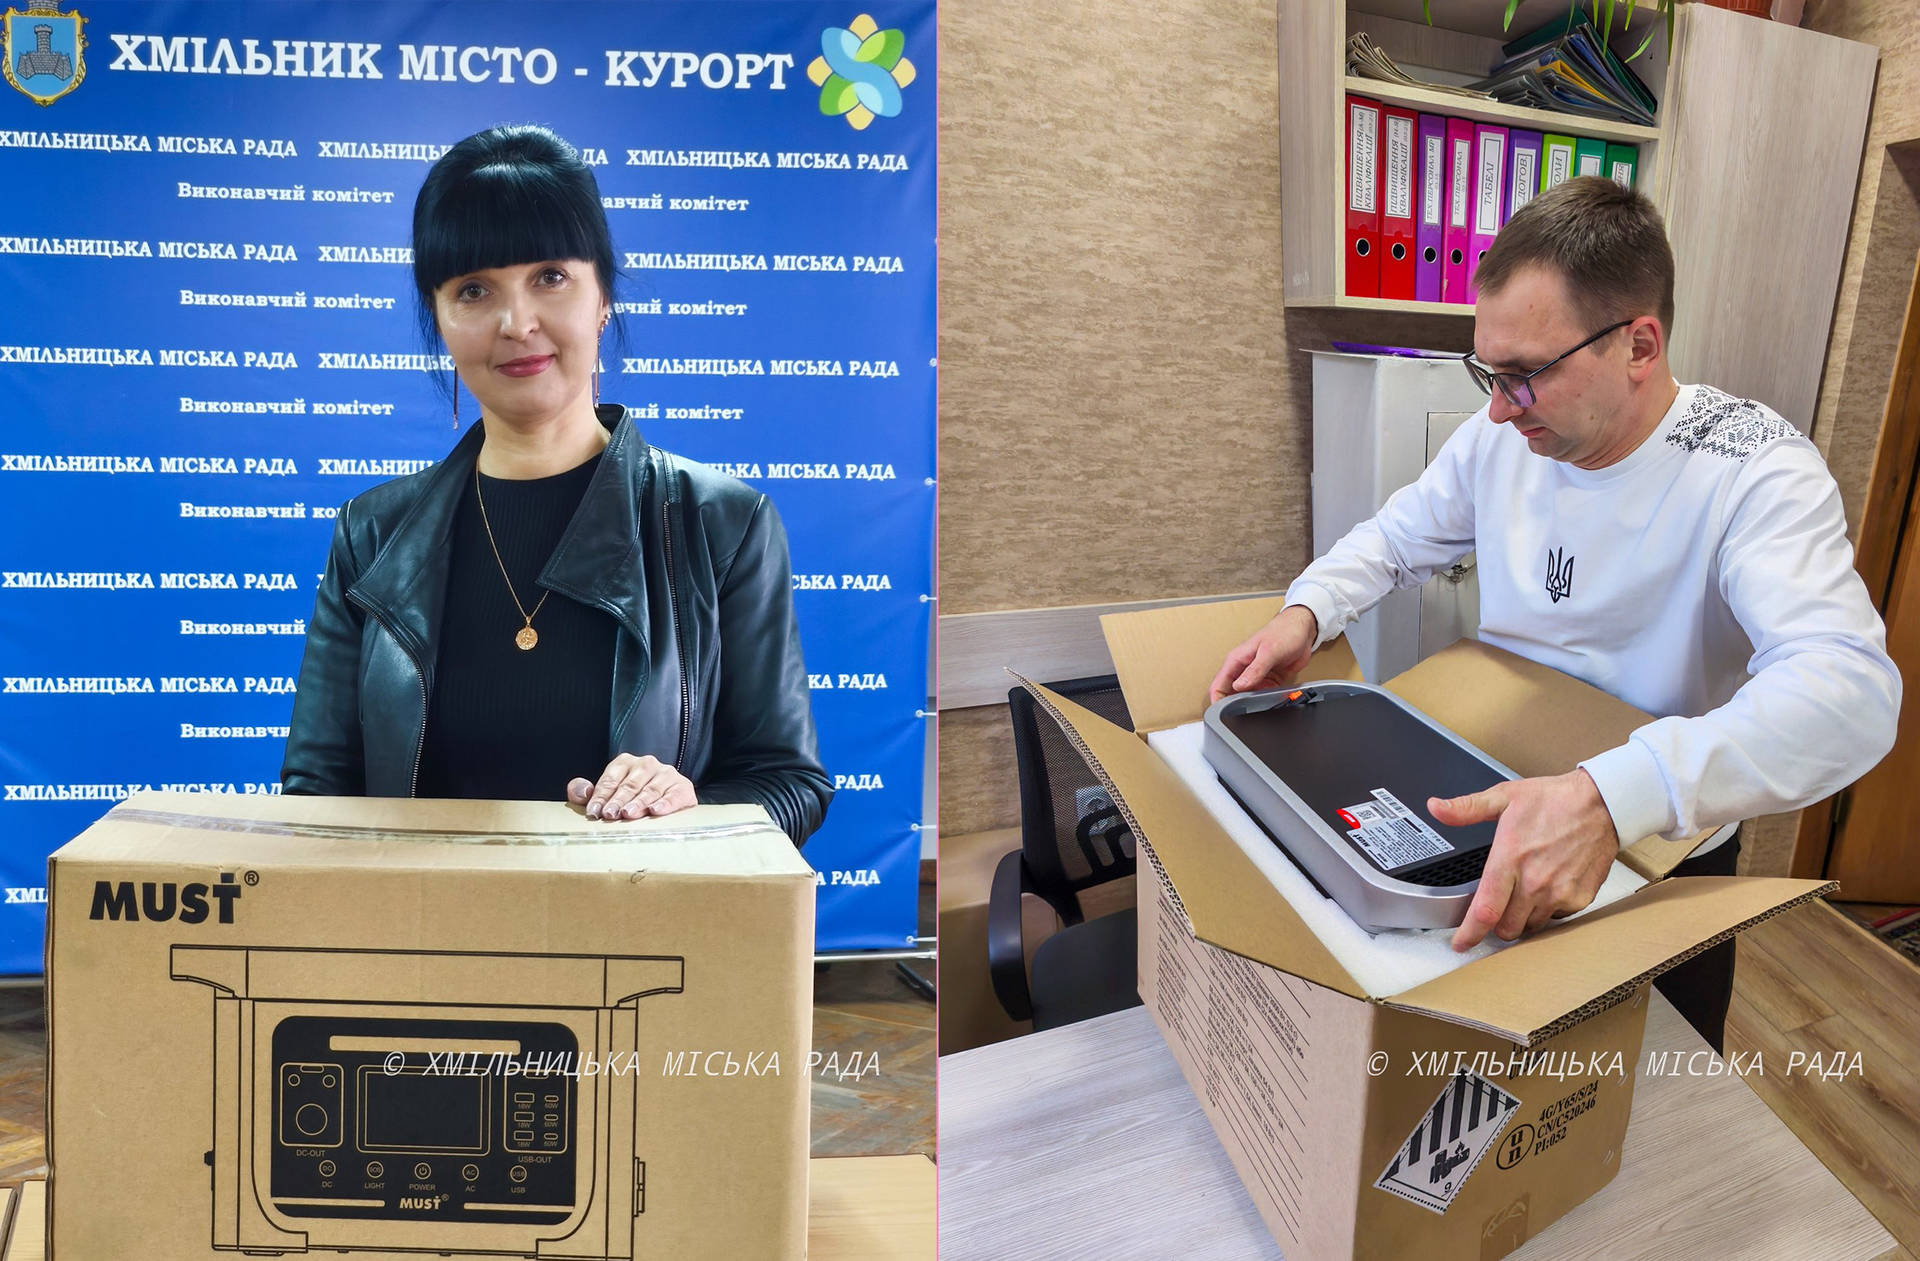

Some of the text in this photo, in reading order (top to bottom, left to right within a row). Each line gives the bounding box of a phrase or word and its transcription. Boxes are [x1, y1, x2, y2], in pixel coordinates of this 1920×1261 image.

[110, 35, 383, 79] ХМІЛЬНИК
[399, 45, 557, 84] МІСТО
[605, 51, 793, 89] КУРОРТ
[0, 131, 297, 158] ХМІЛЬНИЦЬКА МІСЬКА РАДА
[626, 150, 908, 172] ХМІЛЬНИЦЬКА МІСЬКА РАДА
[1484, 161, 1495, 206] ТАБЕЛІ
[178, 183, 394, 203] Виконавчий комітет
[602, 194, 748, 210] авчий комітет
[0, 237, 297, 263] ХМІЛЬНИЦЬКА МІСЬКА РАДА
[318, 246, 415, 264] ХМІЛЬНИ
[624, 253, 903, 274] ХМІЛЬНИЦЬКА МІСЬКА РАДА
[181, 290, 395, 309] Виконавчий комітет
[669, 301, 747, 315] комітет
[0, 347, 297, 370] ХМІЛЬНИЦЬКА МІСЬКА РАДА
[318, 353, 455, 372] ХМІЛЬНИЦЬК
[622, 359, 764, 376] ХМІЛЬНИЦЬКА
[770, 360, 843, 375] МІСЬКА
[849, 361, 899, 378] РАДА
[181, 398, 394, 415] Виконавчий комітет
[666, 405, 743, 419] комітет
[2, 455, 297, 476] ХМІЛЬНИЦЬКА МІСЬКА РАДА
[768, 464, 840, 478] МІСЬКА
[846, 464, 896, 480] РАДА
[181, 503, 305, 518] Виконавчий
[3, 573, 154, 590] ХМІЛЬНИЦЬКА
[161, 574, 238, 588] МІСЬКА
[244, 574, 297, 591] РАДА
[842, 575, 891, 591] РАДА
[181, 620, 305, 634] Виконавчий
[3, 678, 296, 694] ХМІЛЬНИЦЬКА МІСЬКА РАДА
[839, 674, 887, 690] РАДА
[181, 723, 291, 738] Виконавчи
[835, 775, 883, 790] РАДА
[831, 870, 880, 886] РАДА
[296, 1149, 326, 1158] DC-OUT
[518, 1155, 553, 1164] USB-OUT
[364, 1182, 385, 1191] LIGHT
[409, 1183, 436, 1192] POWER
